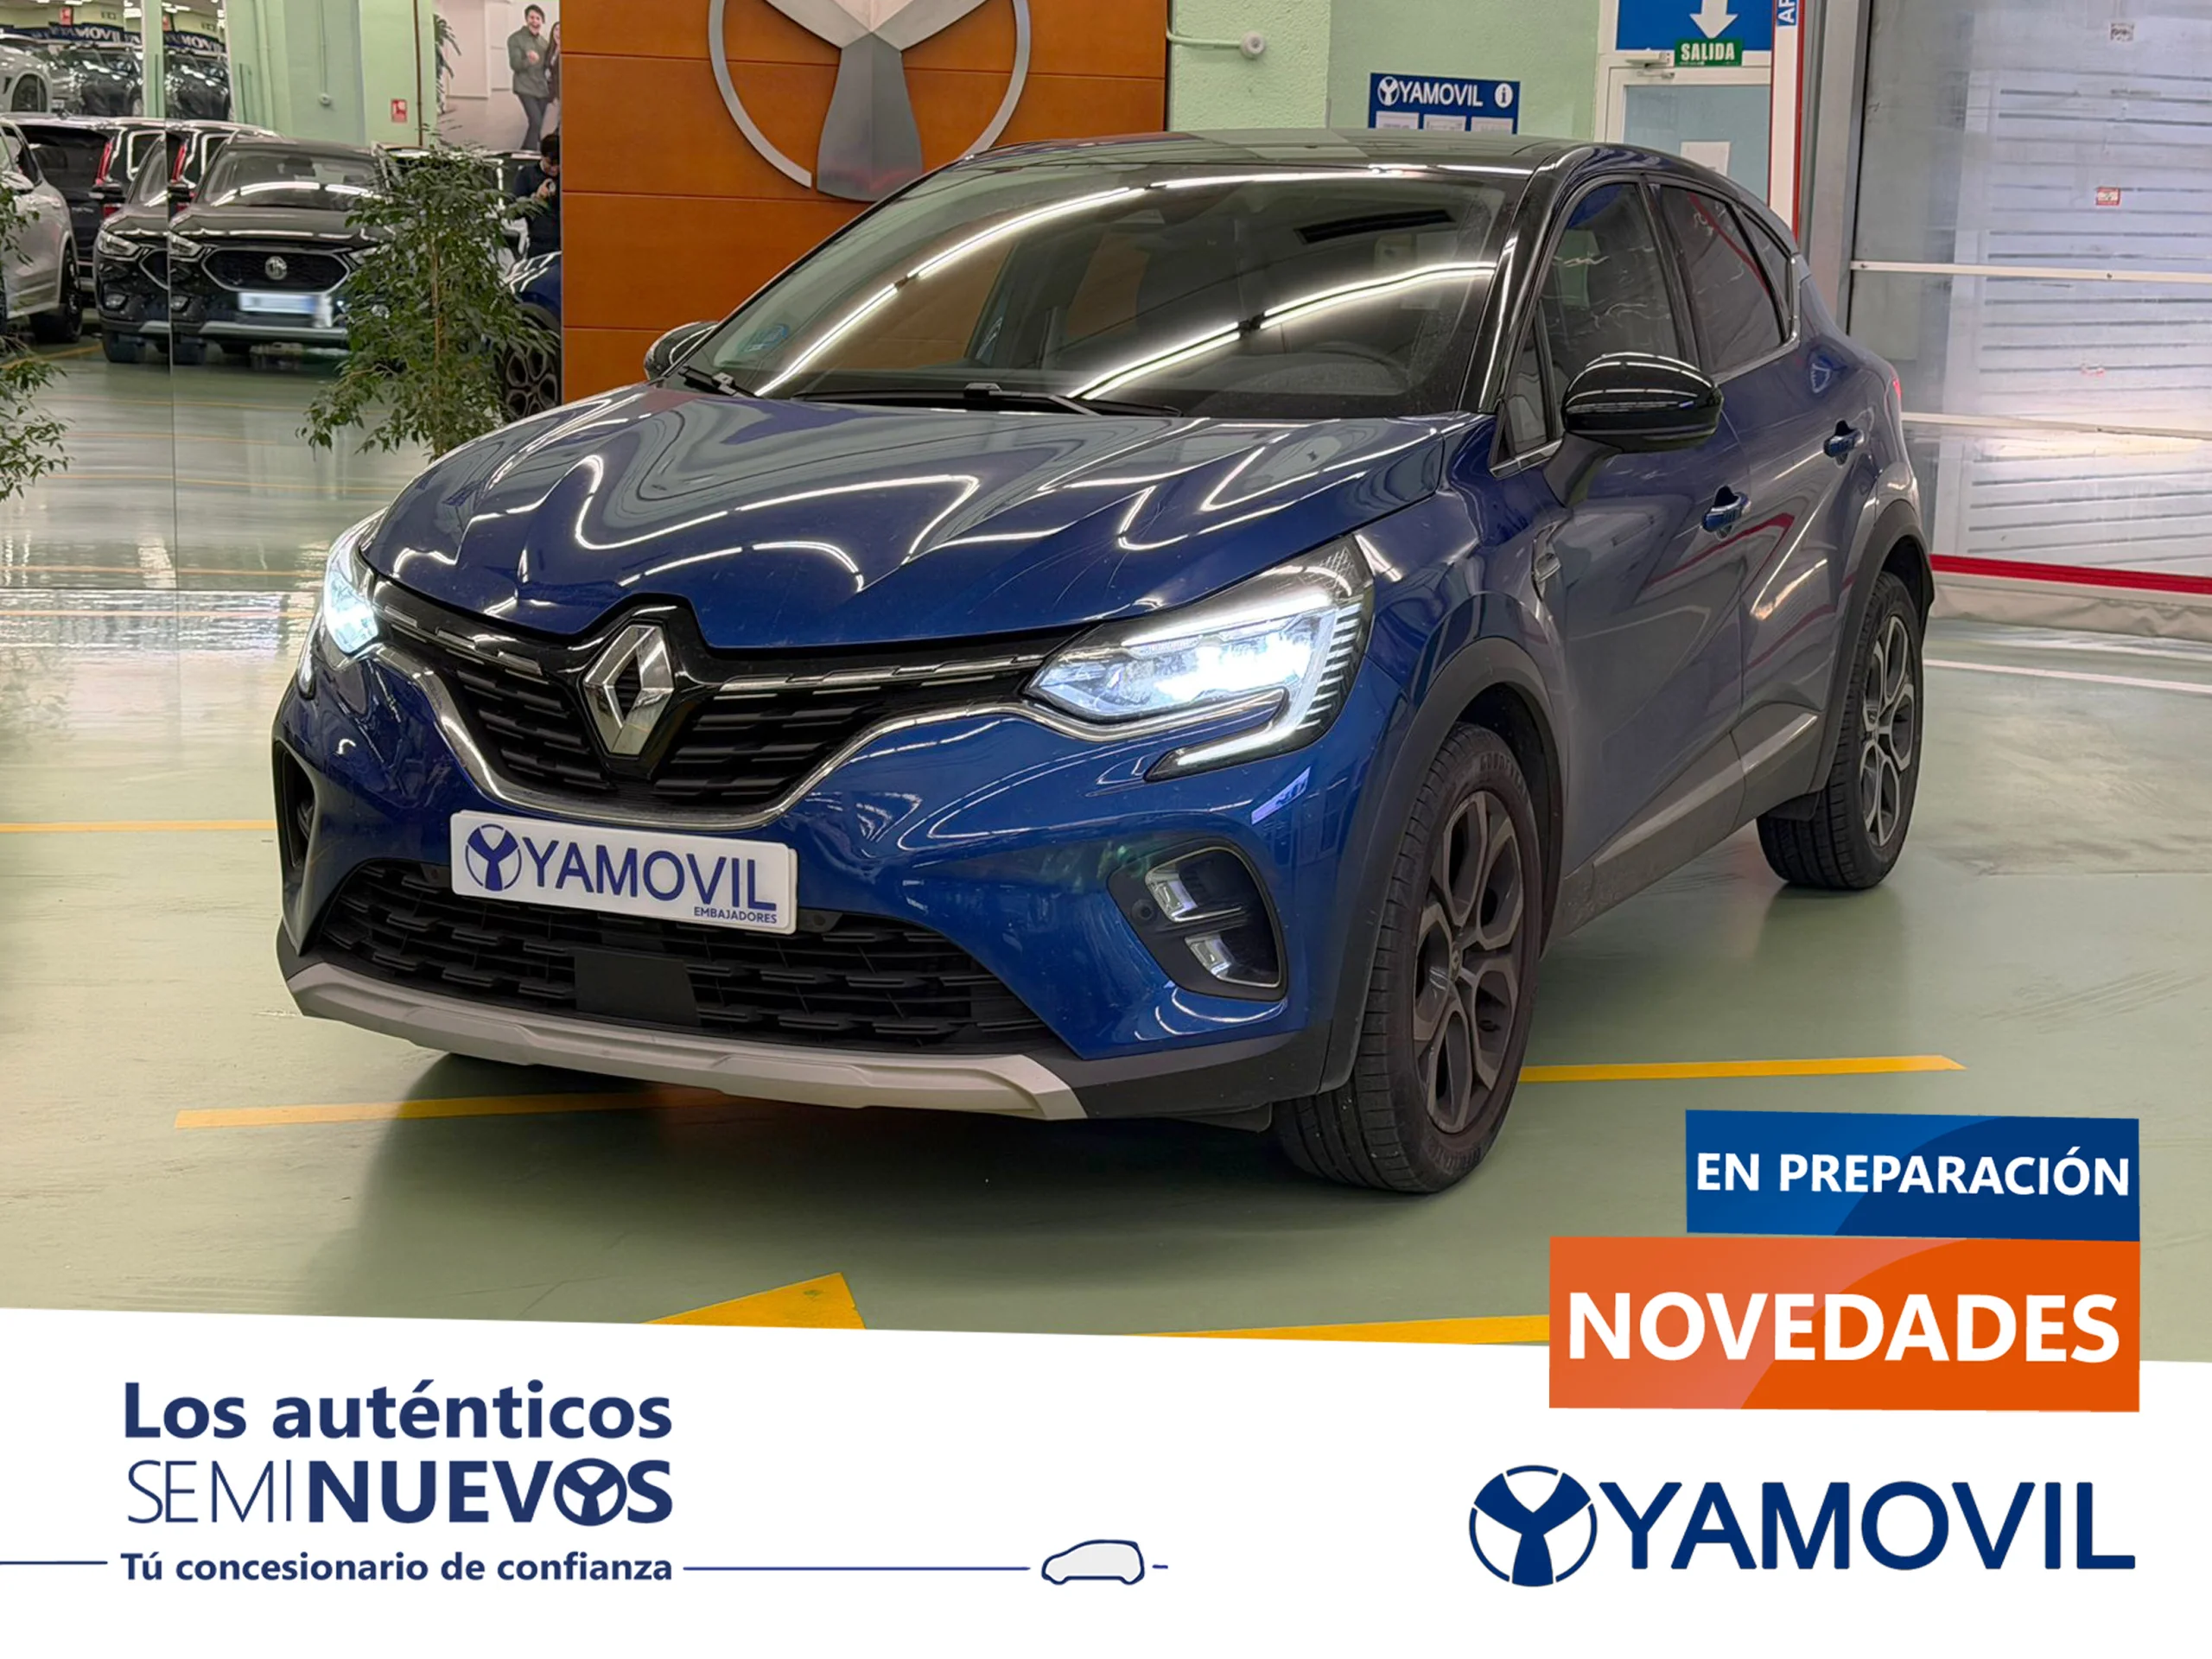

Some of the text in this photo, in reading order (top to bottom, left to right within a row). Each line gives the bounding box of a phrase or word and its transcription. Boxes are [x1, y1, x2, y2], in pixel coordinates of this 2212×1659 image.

[1681, 42, 1735, 61] SALIDA
[1399, 80, 1484, 107] YAMOVIL
[523, 836, 777, 912] YAMOVIL
[694, 906, 778, 925] EMBAJADORES
